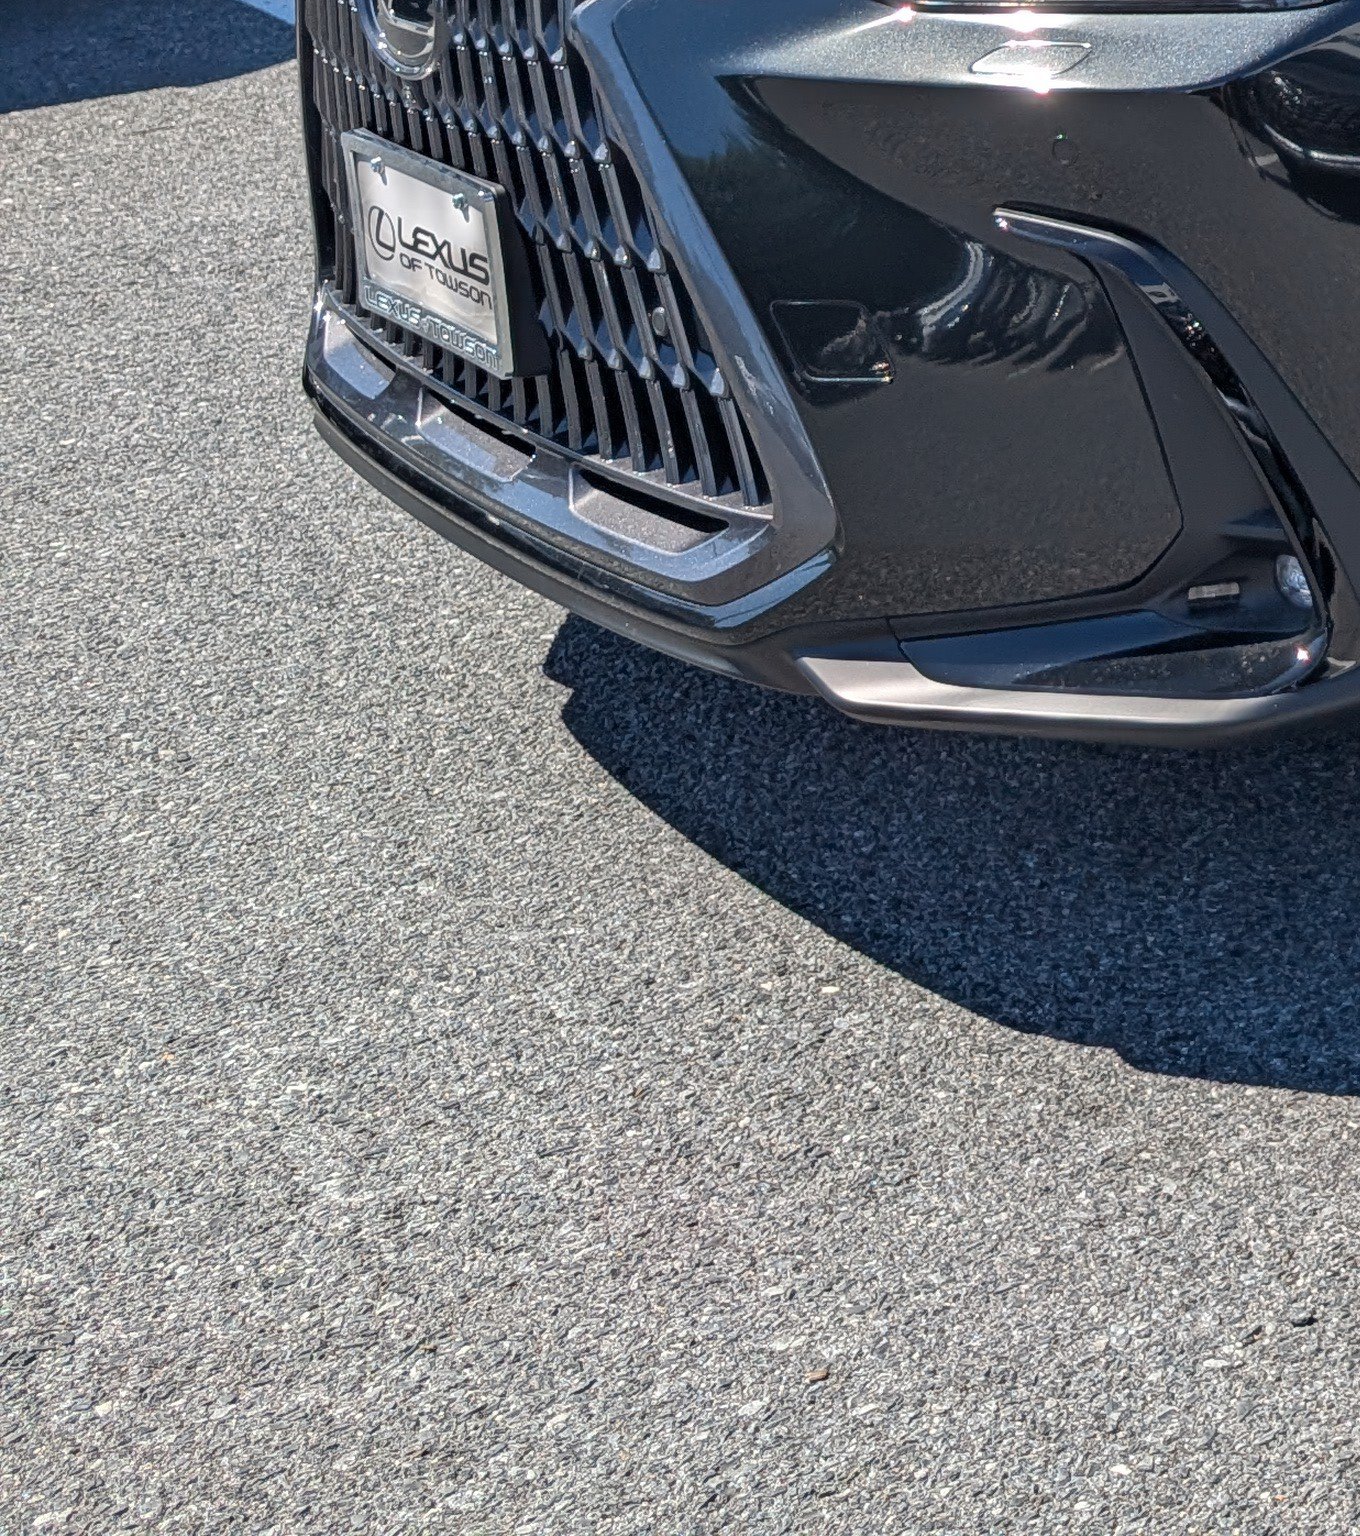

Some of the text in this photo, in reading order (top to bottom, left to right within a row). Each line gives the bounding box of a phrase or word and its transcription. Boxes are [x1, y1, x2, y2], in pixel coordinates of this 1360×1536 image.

[398, 216, 490, 286] LEXUS
[399, 252, 493, 310] OF TOWSON
[364, 285, 421, 329] LEXUS
[428, 315, 502, 371] TOWSON
